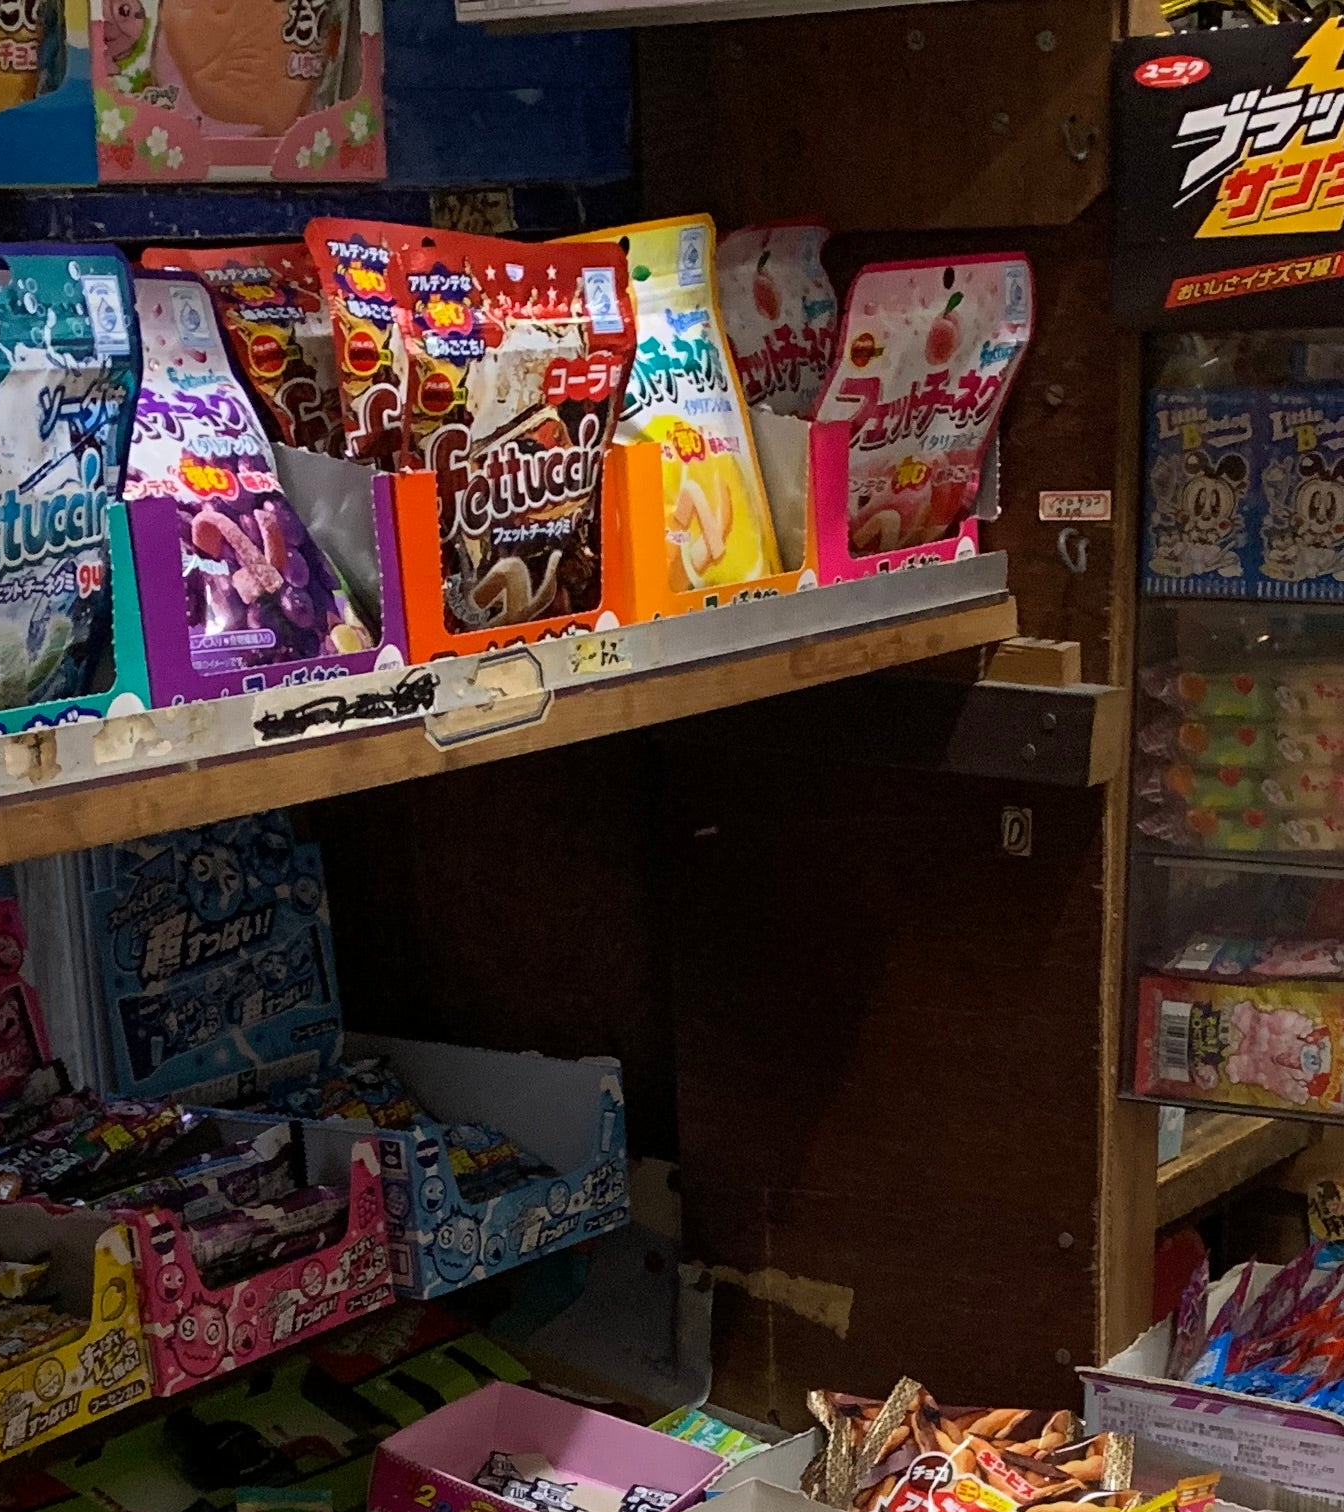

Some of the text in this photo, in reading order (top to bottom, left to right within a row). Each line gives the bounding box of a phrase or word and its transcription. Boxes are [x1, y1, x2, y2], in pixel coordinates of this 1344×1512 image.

[1143, 60, 1204, 80] ユーラク
[408, 274, 472, 291] アルデンテな
[1176, 254, 1343, 301] おいしさイナズマ級!
[492, 521, 572, 545] フェットチーネグミ
[977, 1450, 1036, 1499] ギンビス
